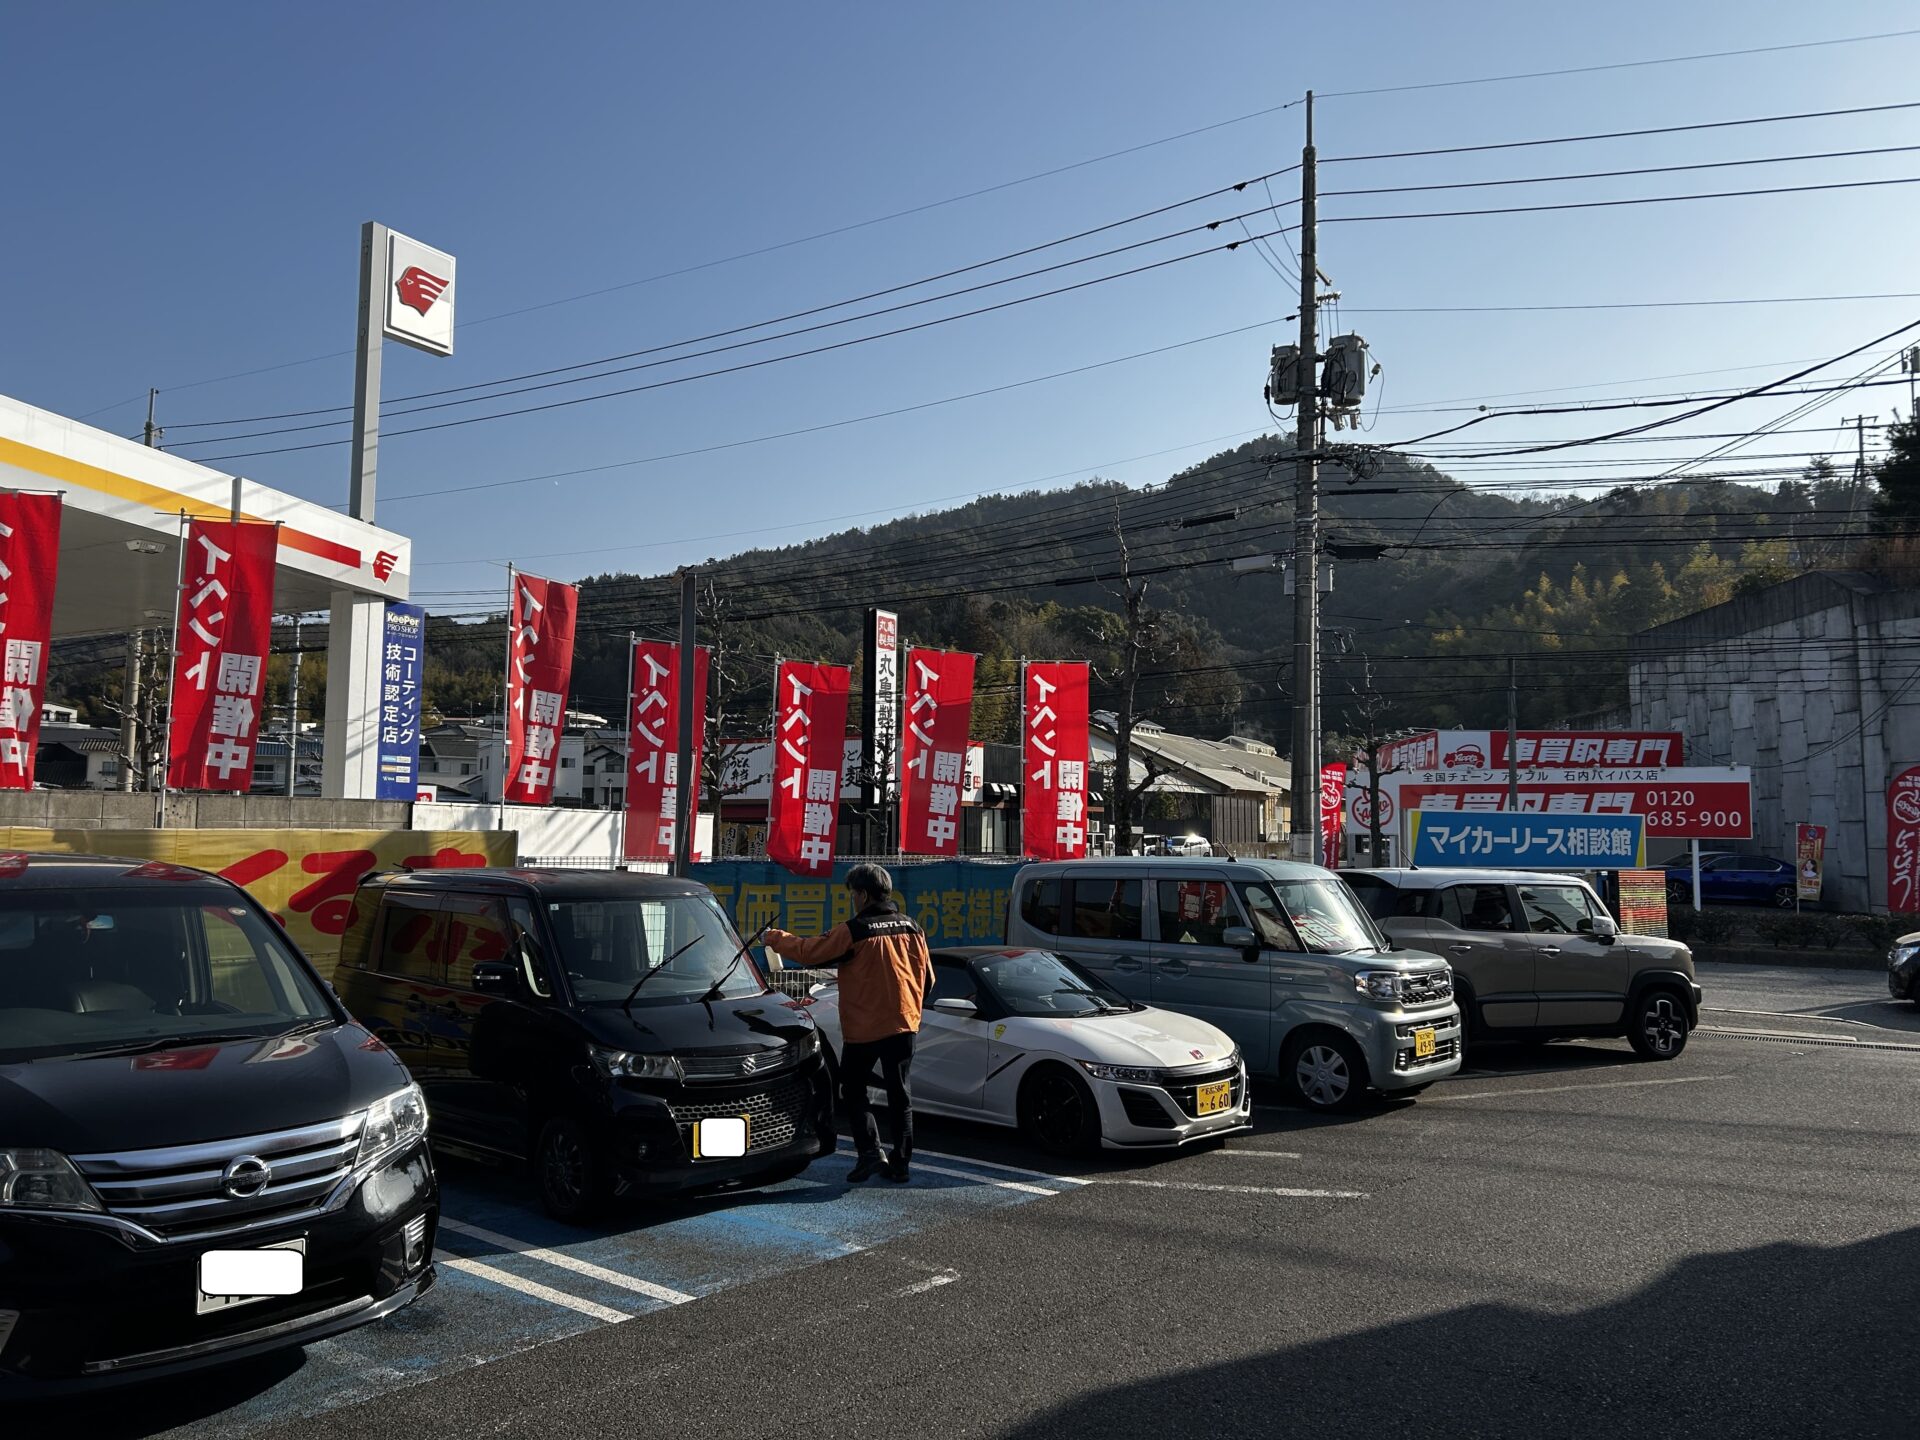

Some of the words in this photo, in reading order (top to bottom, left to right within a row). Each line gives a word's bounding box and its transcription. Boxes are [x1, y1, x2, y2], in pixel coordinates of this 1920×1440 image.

[386, 611, 420, 627] KeePer
[382, 642, 401, 744] 技術認定店
[400, 646, 416, 745] コーティング
[1503, 738, 1671, 765] 車買取専門
[1423, 772, 1493, 783] 全国チェーン
[1647, 791, 1694, 806] 0120
[1647, 811, 1742, 827] 685-900
[1427, 826, 1632, 856] マイカーリース相談館
[868, 920, 912, 930] HUSTLER
